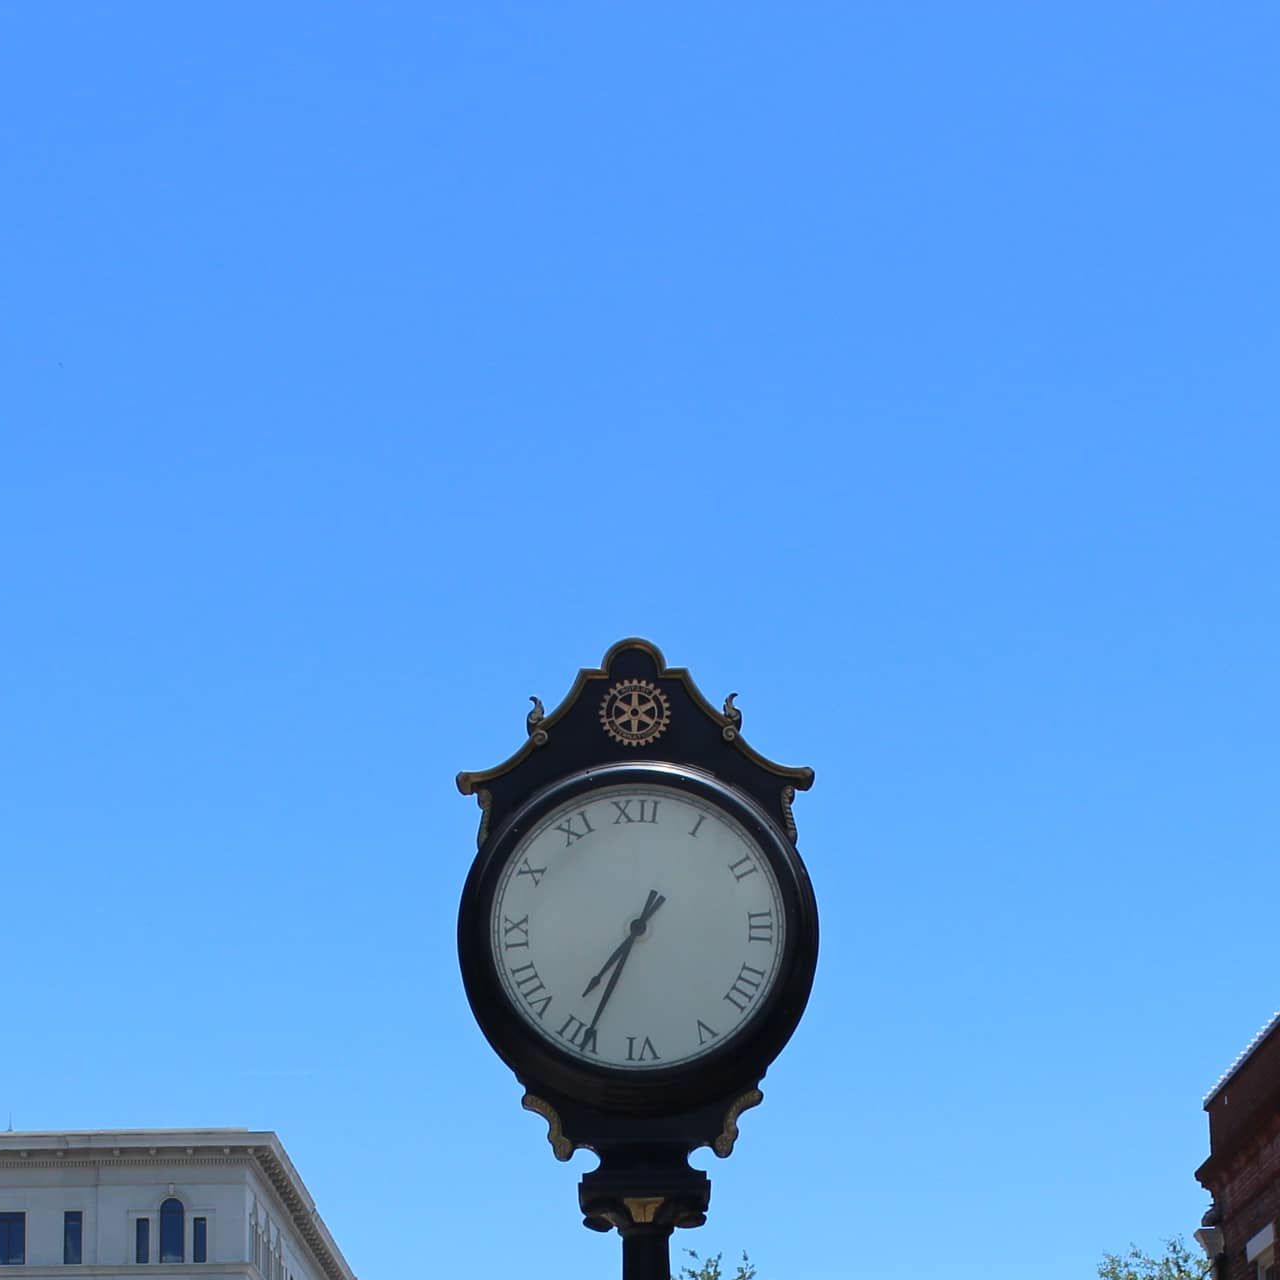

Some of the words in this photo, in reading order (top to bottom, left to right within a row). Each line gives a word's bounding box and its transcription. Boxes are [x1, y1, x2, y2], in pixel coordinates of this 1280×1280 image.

[611, 800, 660, 824] XII
[687, 814, 707, 838] I
[554, 809, 596, 848] XI
[517, 857, 547, 887] X
[728, 855, 757, 882] II
[504, 914, 529, 949] IX
[747, 908, 773, 944] III
[510, 960, 554, 1020] VIII
[722, 962, 767, 1013] IIII
[555, 1015, 600, 1054] VII
[695, 1018, 719, 1046] V
[626, 1036, 661, 1062] VI
